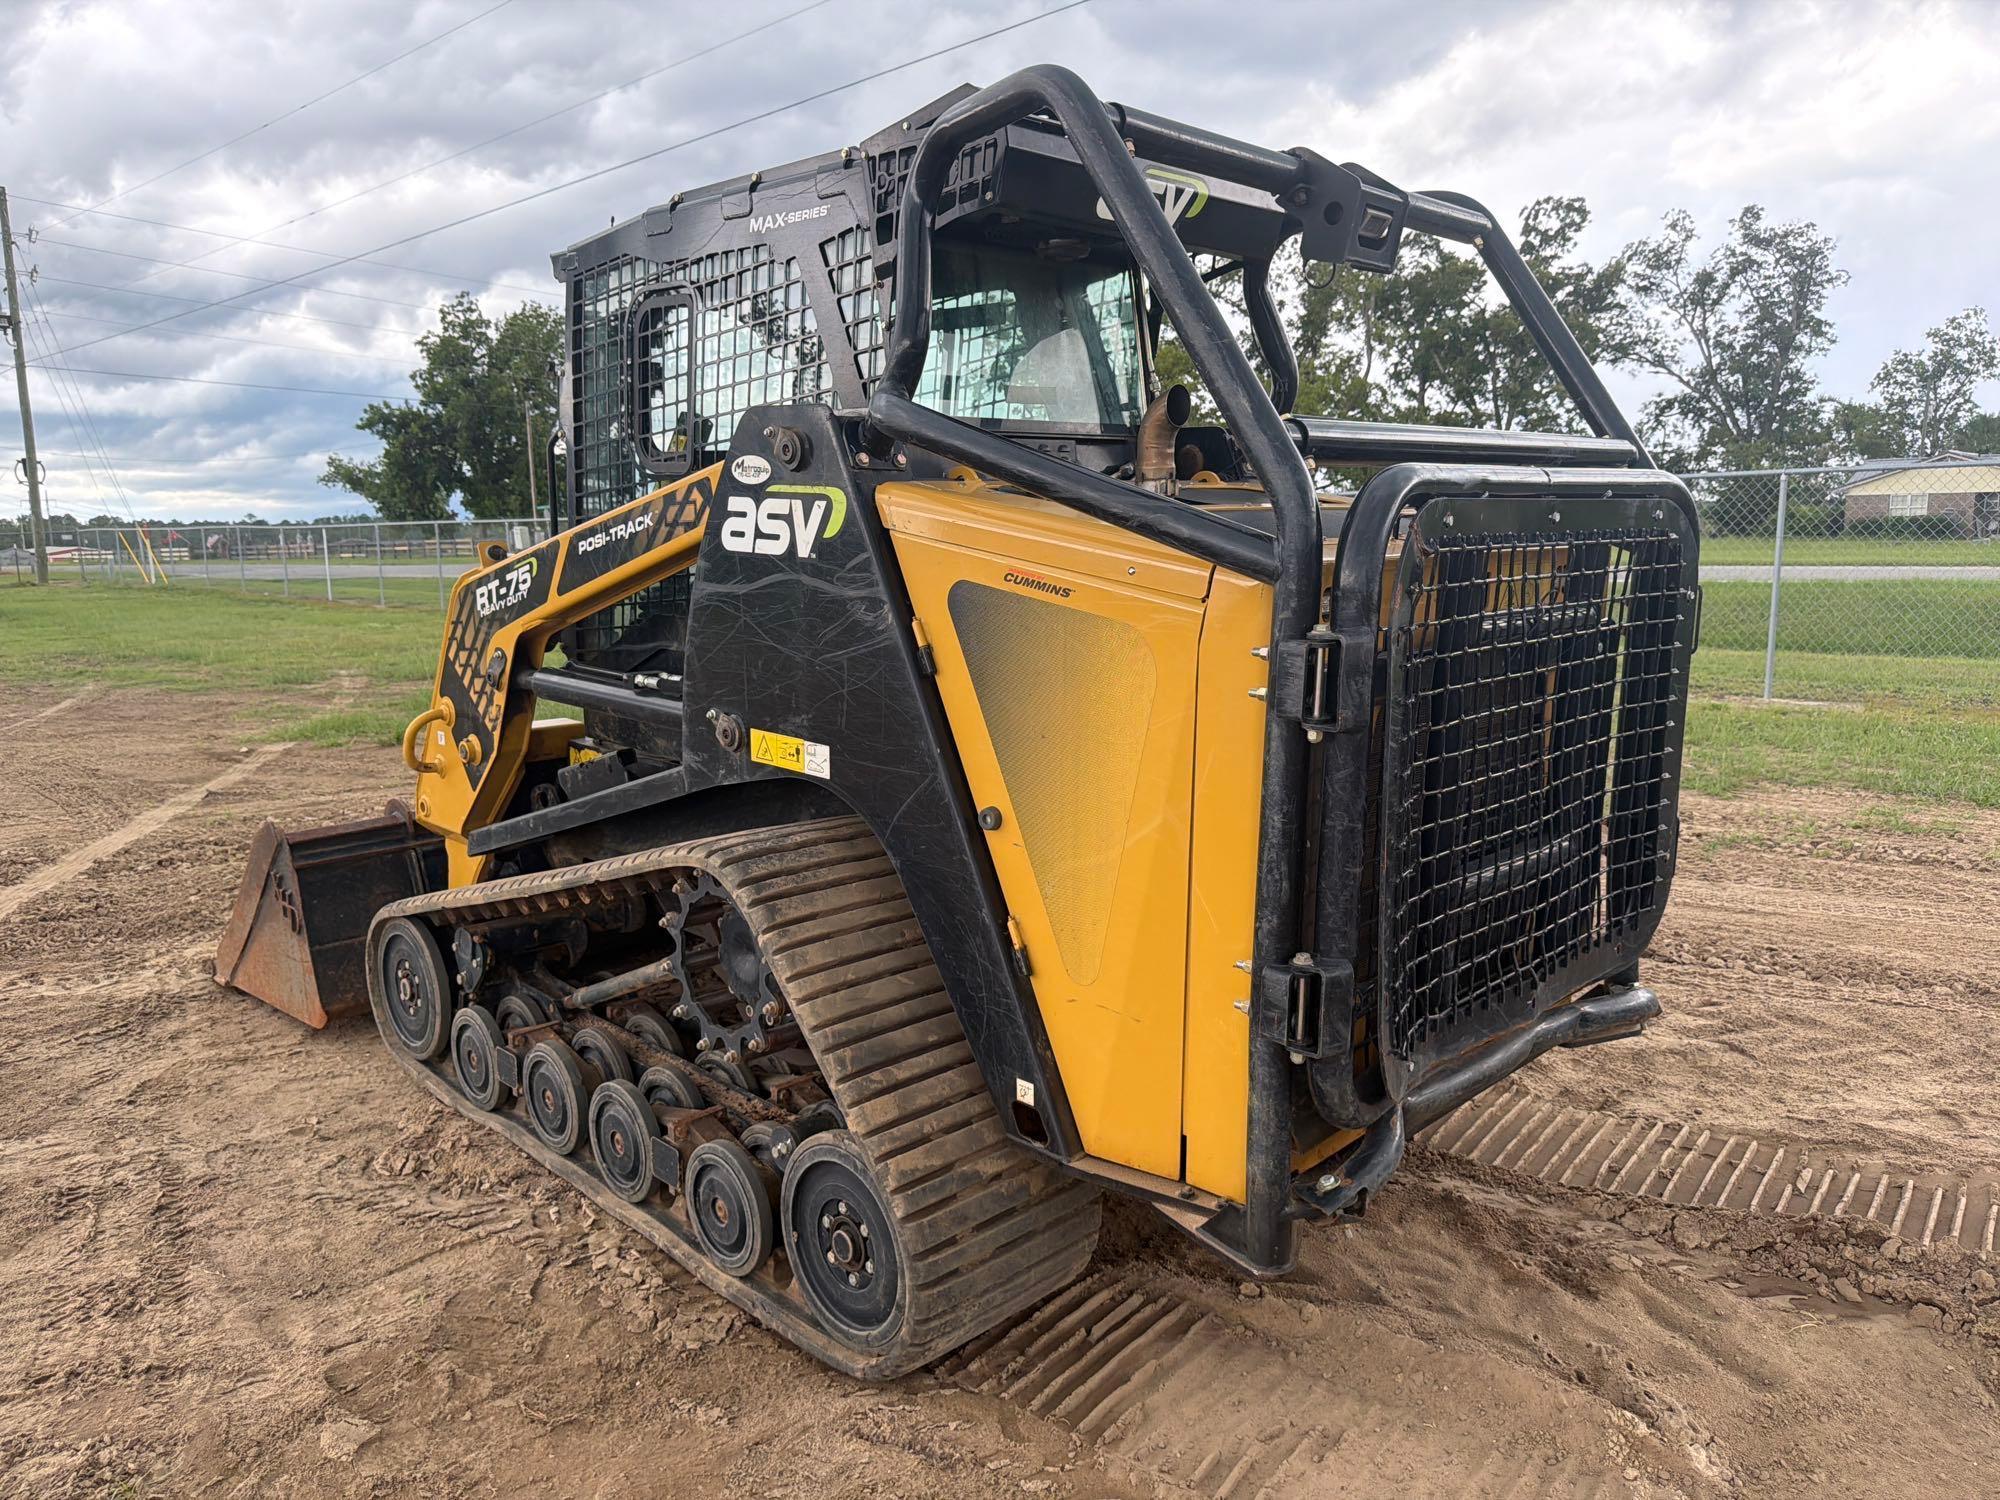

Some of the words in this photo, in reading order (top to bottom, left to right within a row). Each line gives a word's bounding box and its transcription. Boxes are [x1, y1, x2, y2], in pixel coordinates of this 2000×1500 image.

[578, 512, 653, 555] POSI-TRACK
[476, 564, 531, 611] RT-75
[1003, 572, 1072, 598] CUMMINS
[480, 599, 506, 618] HEAVY
[506, 589, 528, 607] DUTY
